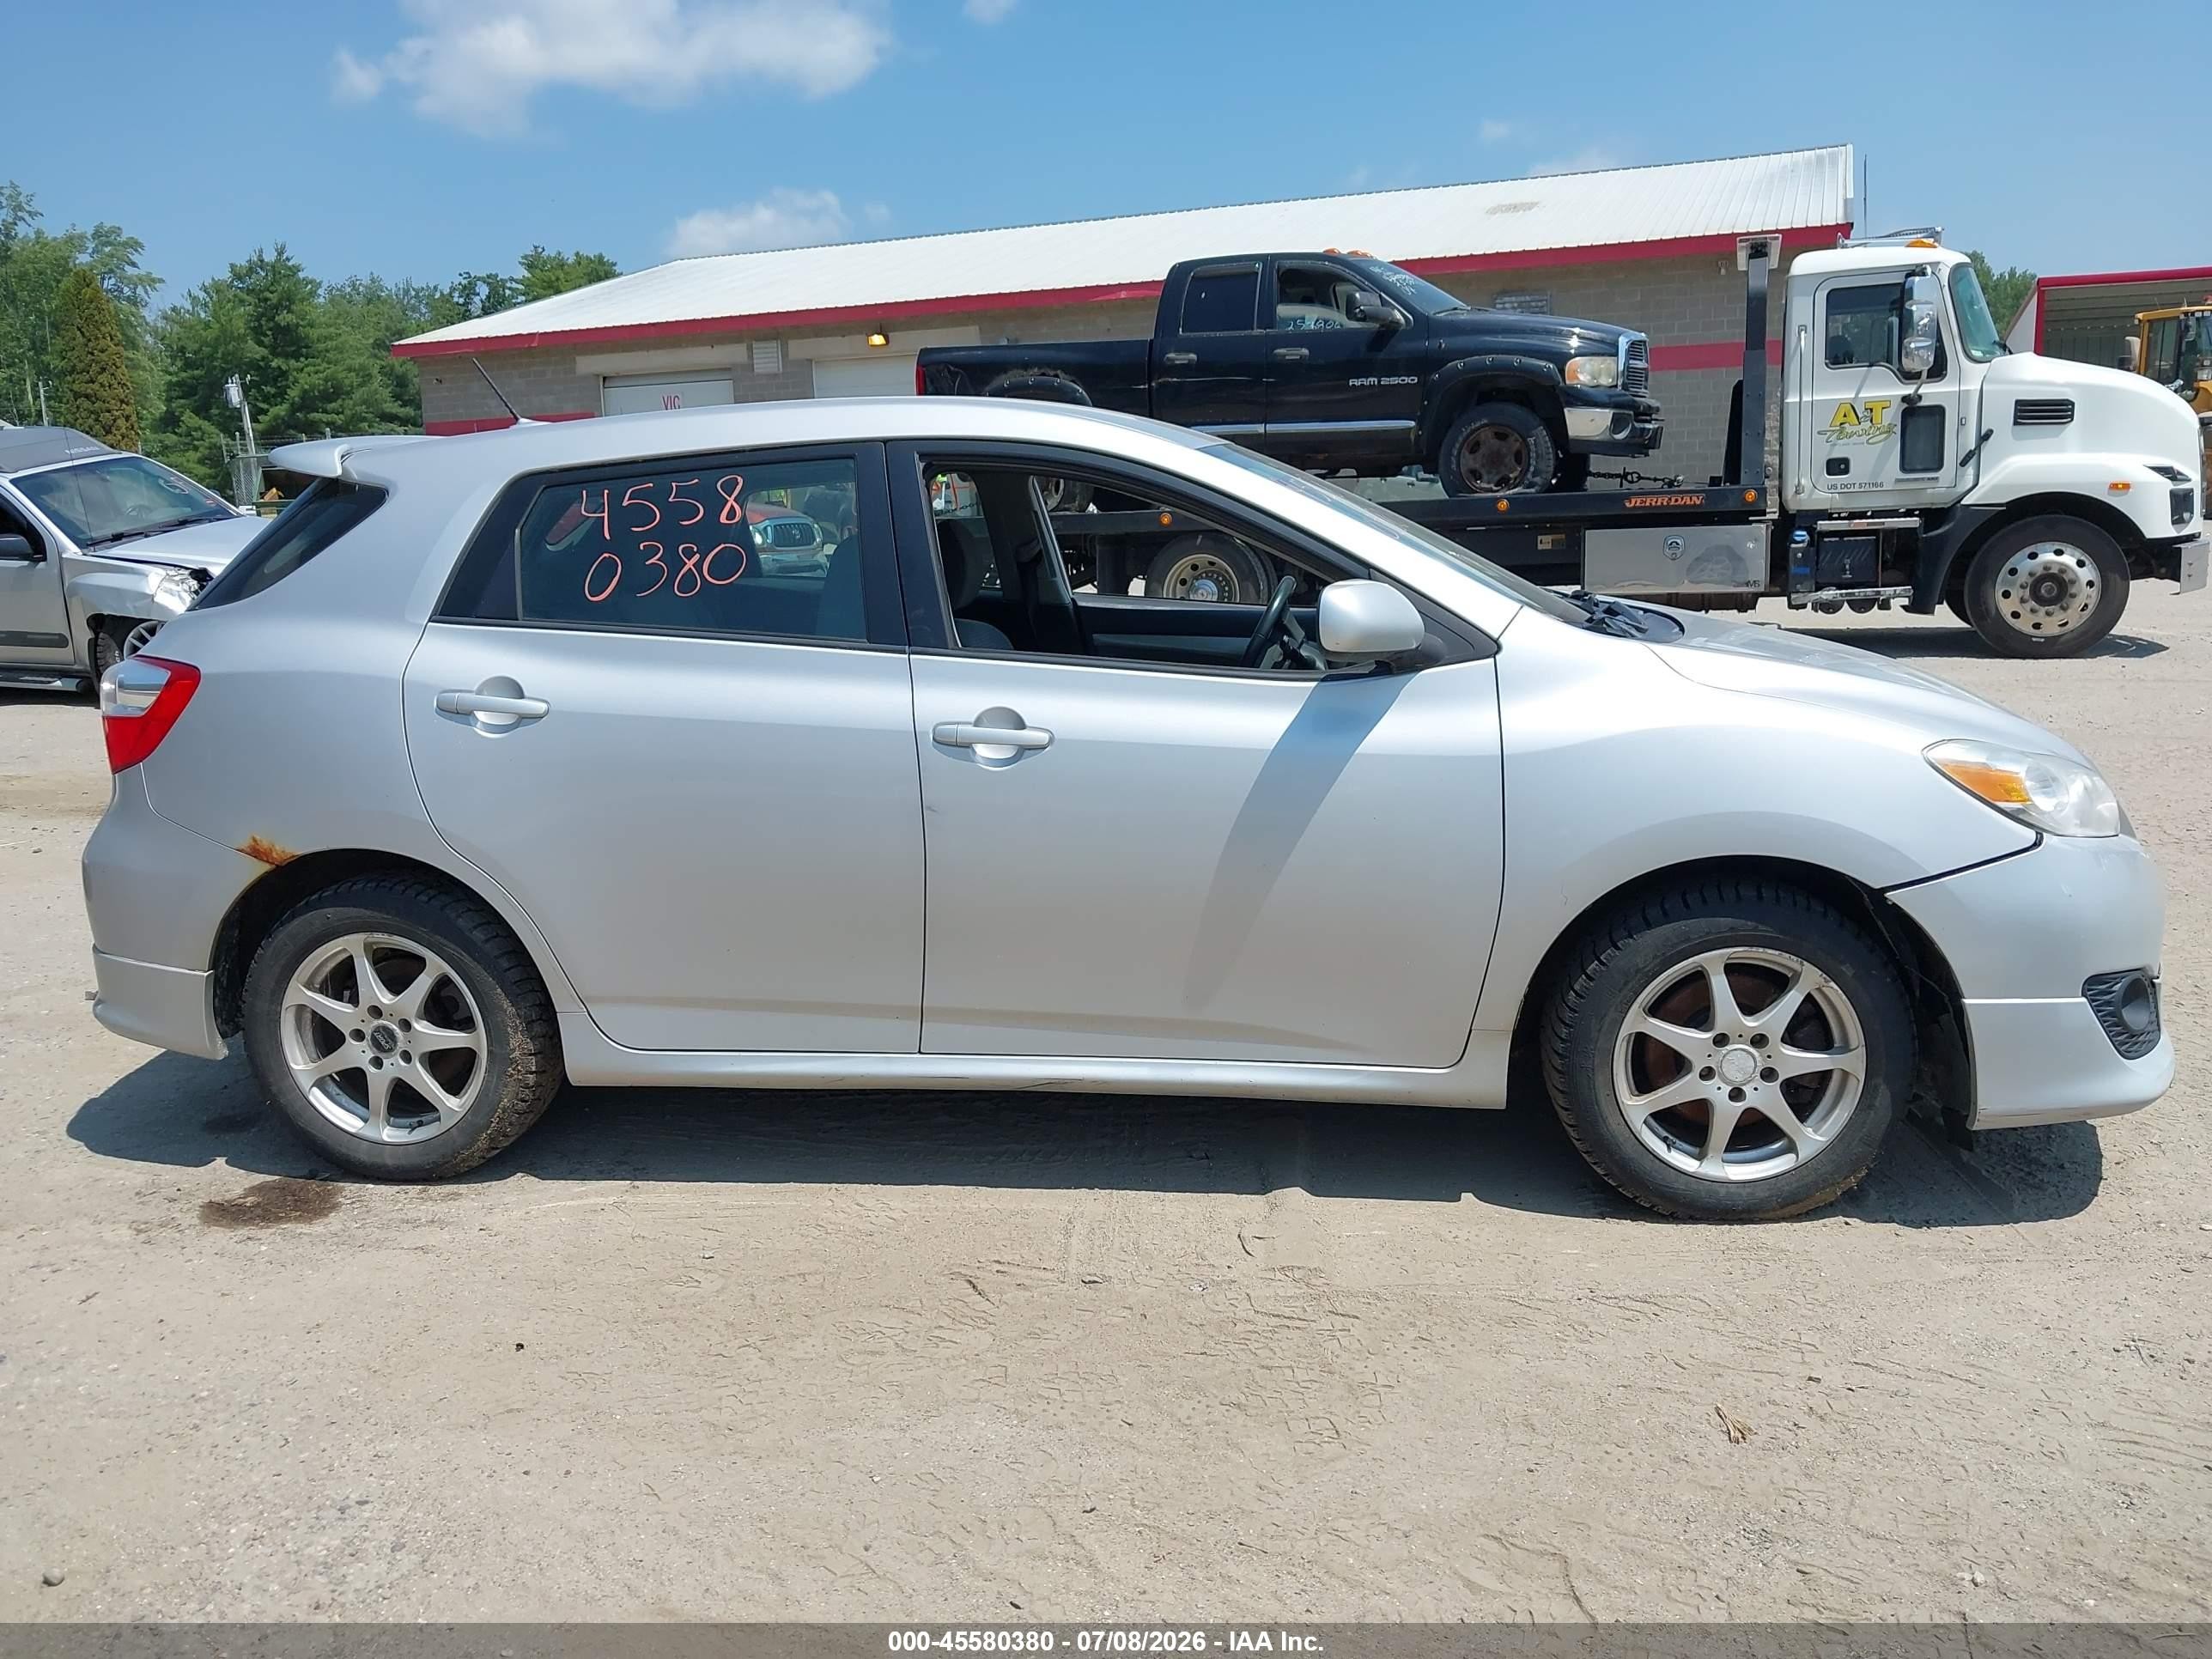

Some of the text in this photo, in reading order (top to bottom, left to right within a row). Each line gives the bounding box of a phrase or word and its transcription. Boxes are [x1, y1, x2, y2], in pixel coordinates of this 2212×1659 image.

[1348, 376, 1419, 386] RAM 2500
[1829, 400, 1891, 428] A&T
[1817, 423, 1897, 445] Towing
[1839, 482, 1857, 490] DOT
[1857, 481, 1885, 490] 571166
[580, 474, 744, 541] 4558
[584, 541, 747, 602] 0380
